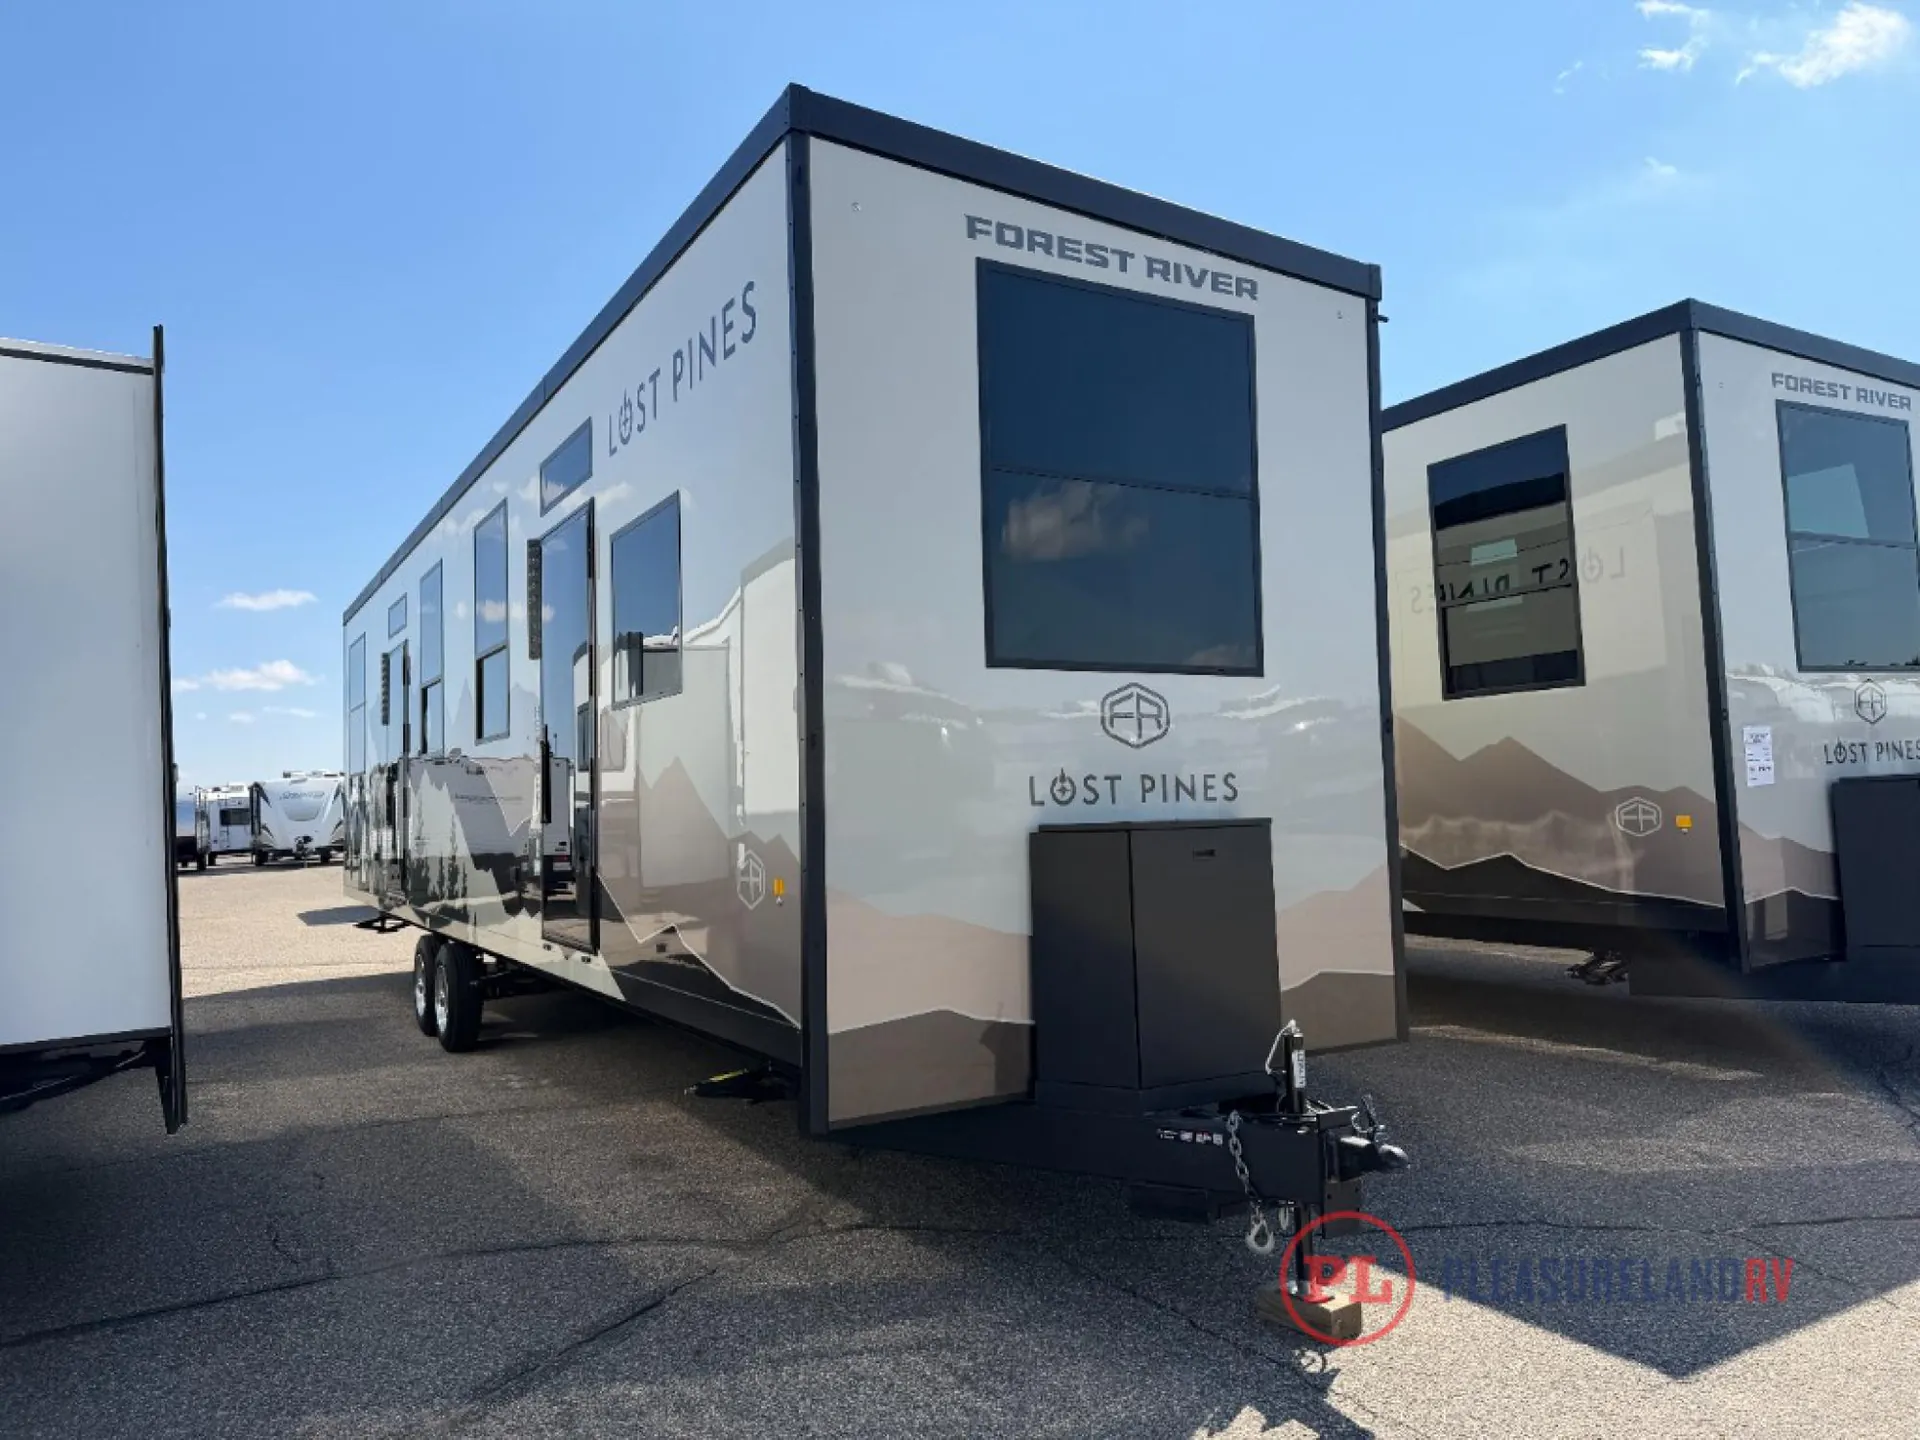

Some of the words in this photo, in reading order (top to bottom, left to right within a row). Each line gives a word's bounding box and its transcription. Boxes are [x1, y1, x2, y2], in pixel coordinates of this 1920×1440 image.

[964, 213, 1135, 273] FOREST
[1143, 254, 1259, 300] RIVER
[608, 367, 661, 457] LOST
[672, 280, 756, 403] PINES
[1771, 372, 1851, 400] FOREST
[1856, 386, 1911, 411] RIVER
[1824, 738, 1867, 764] LOST
[1029, 768, 1122, 806] LOST
[1140, 772, 1239, 803] PINES
